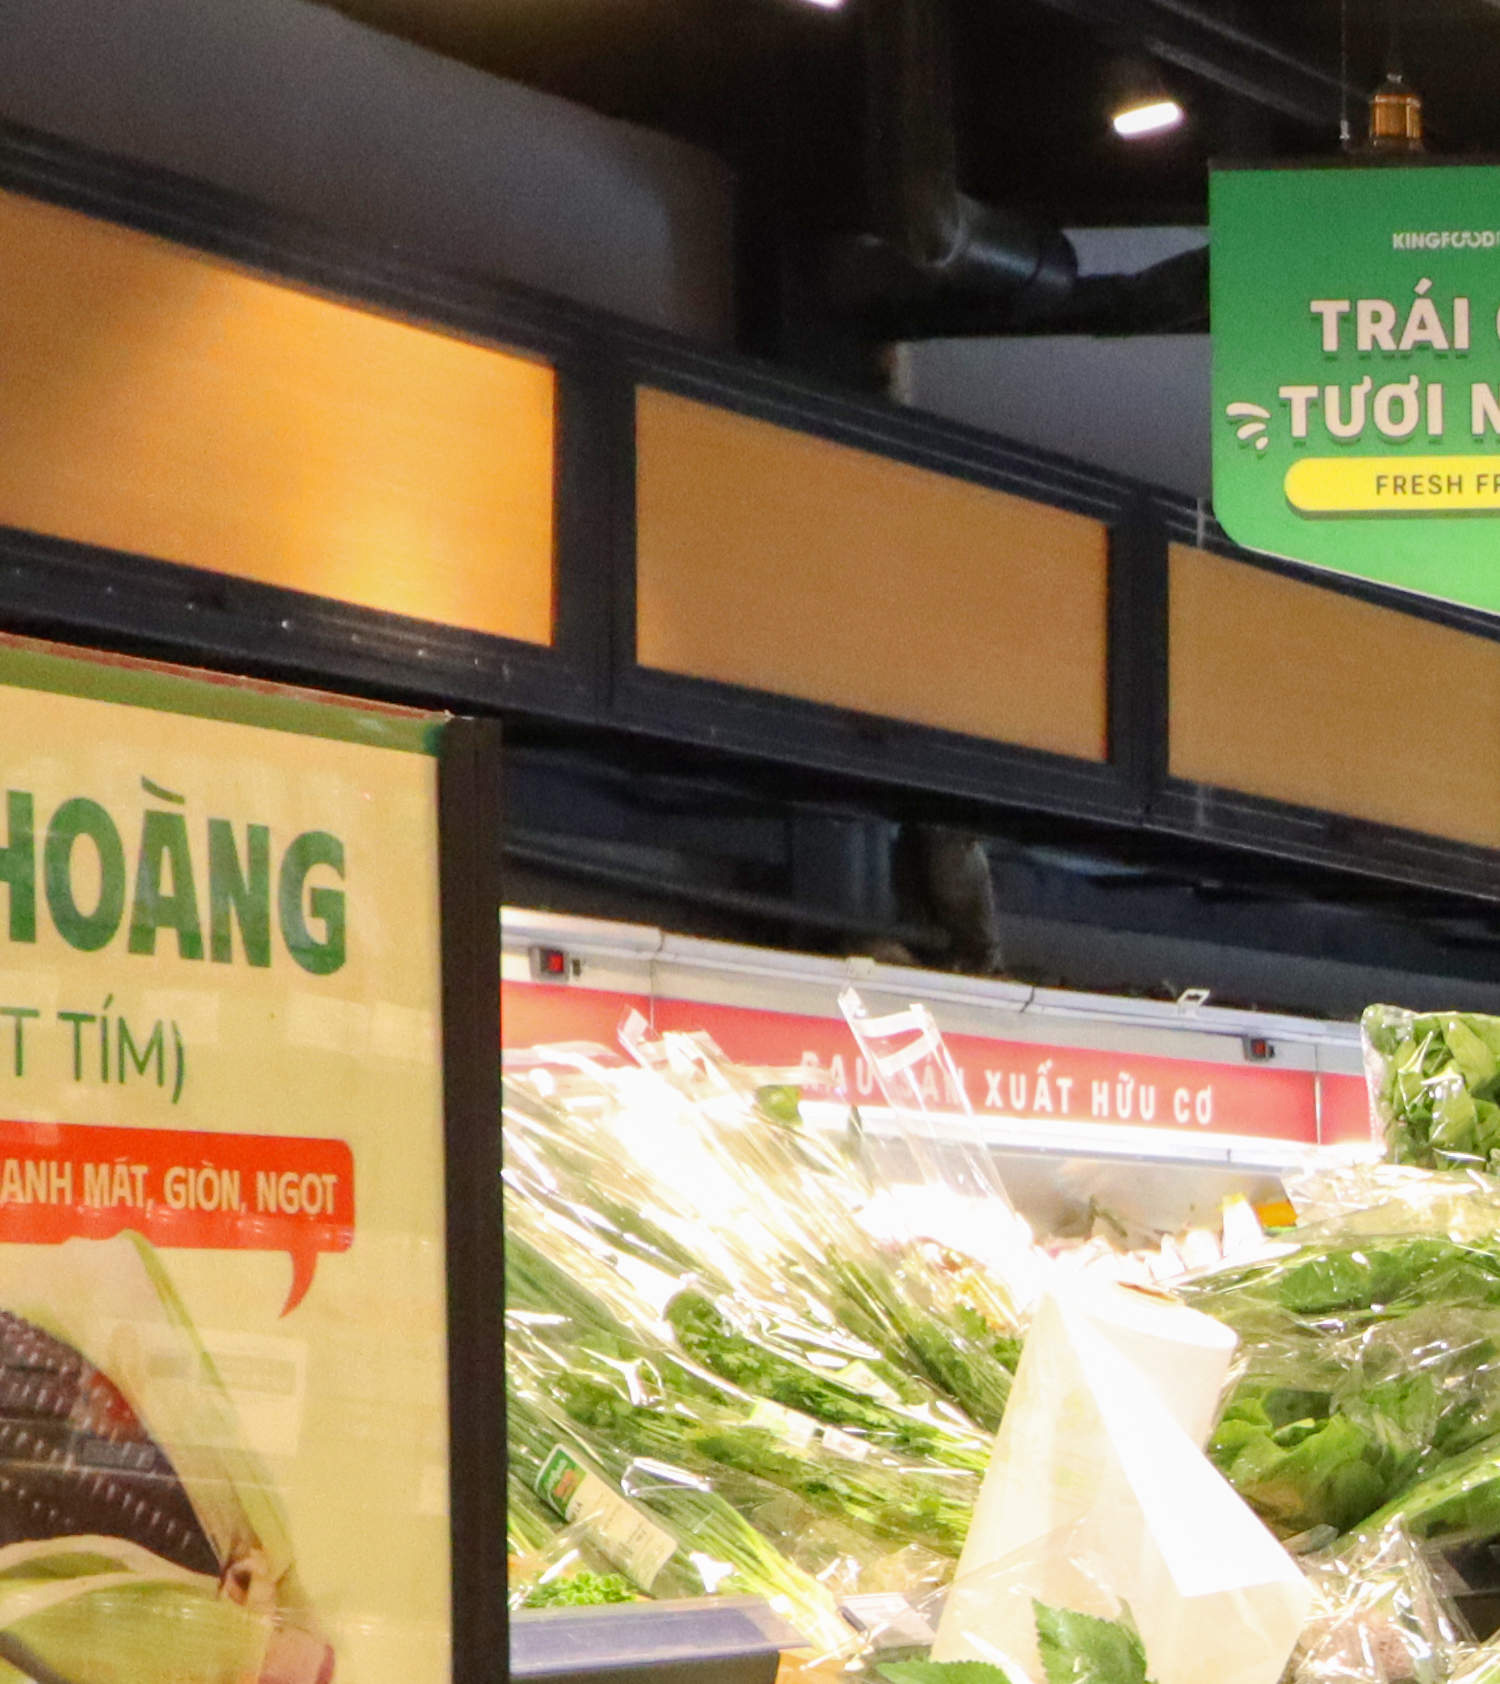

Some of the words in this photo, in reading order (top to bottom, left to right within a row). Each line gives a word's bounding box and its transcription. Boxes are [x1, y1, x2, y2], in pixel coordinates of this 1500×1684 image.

[1310, 277, 1470, 353] TRÁI
[1278, 375, 1445, 440] TƯƠI
[1375, 472, 1464, 496] FRESH
[57, 993, 184, 1104] TÍM)
[984, 1059, 1074, 1115] XUẤT
[1091, 1072, 1157, 1121] HỮU
[1173, 1086, 1214, 1126] CƠ
